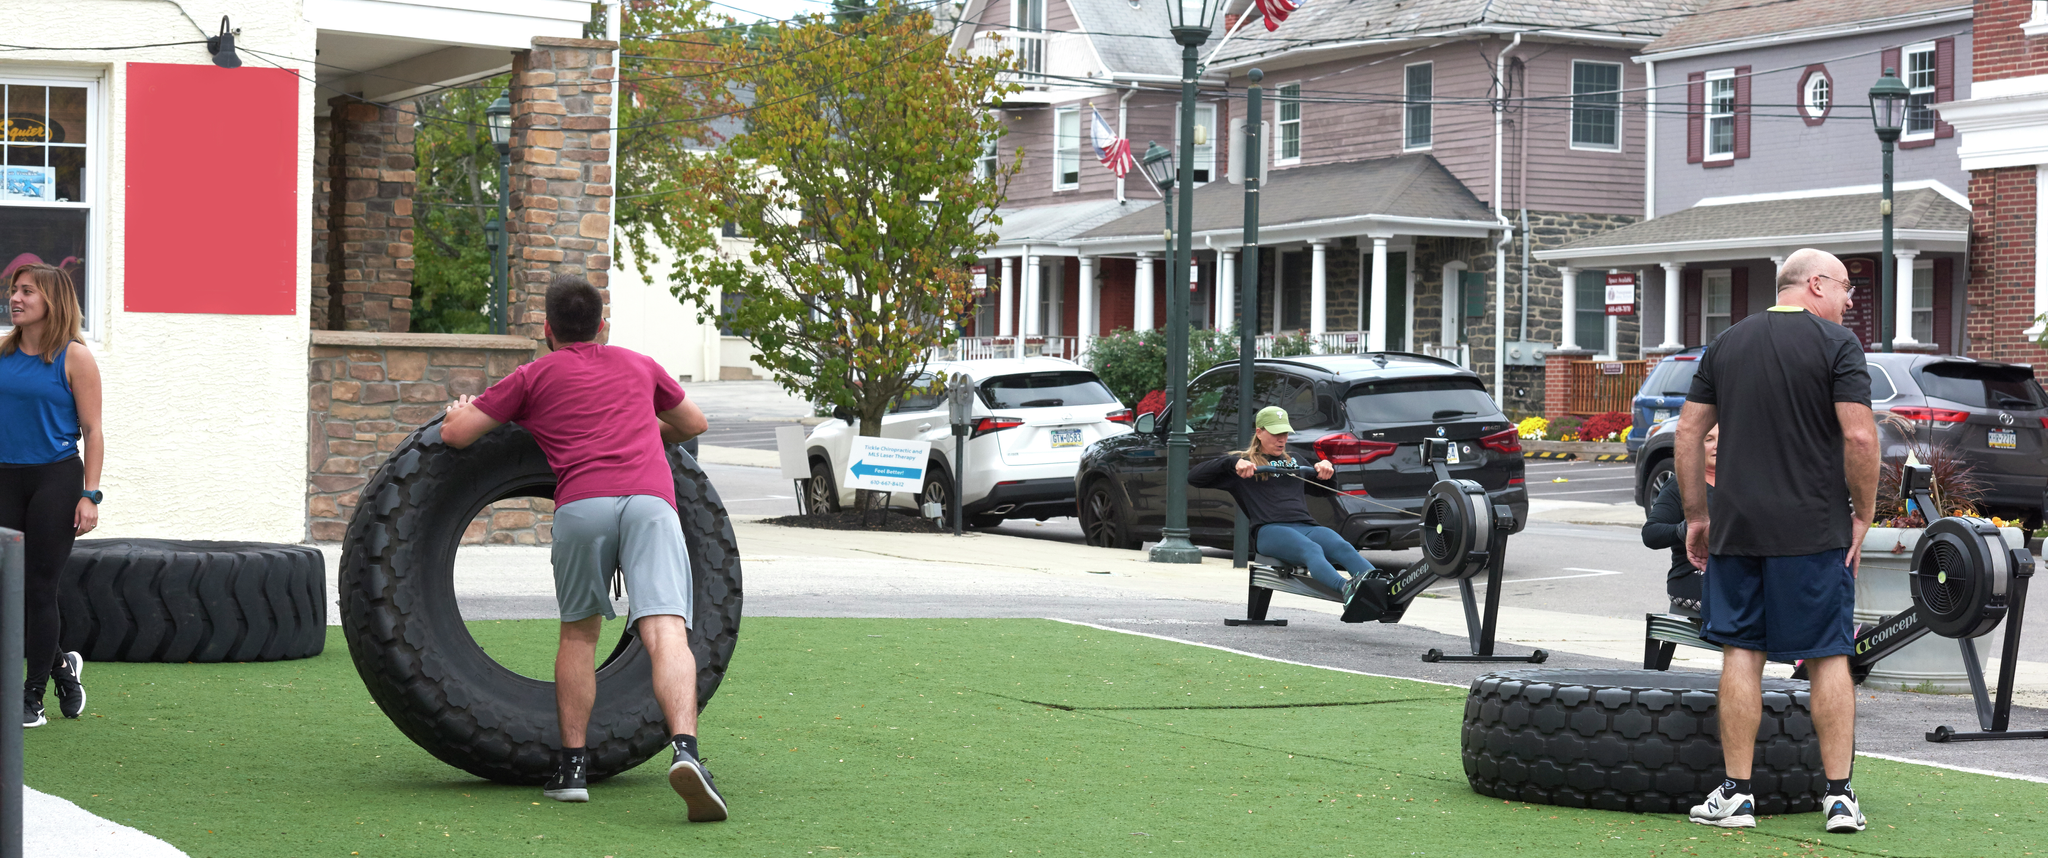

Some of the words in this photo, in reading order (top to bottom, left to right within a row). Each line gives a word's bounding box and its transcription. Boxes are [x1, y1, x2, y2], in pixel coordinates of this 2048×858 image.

[880, 446, 912, 454] Chiropractic
[1401, 562, 1430, 588] concep
[1871, 612, 1919, 646] concept
